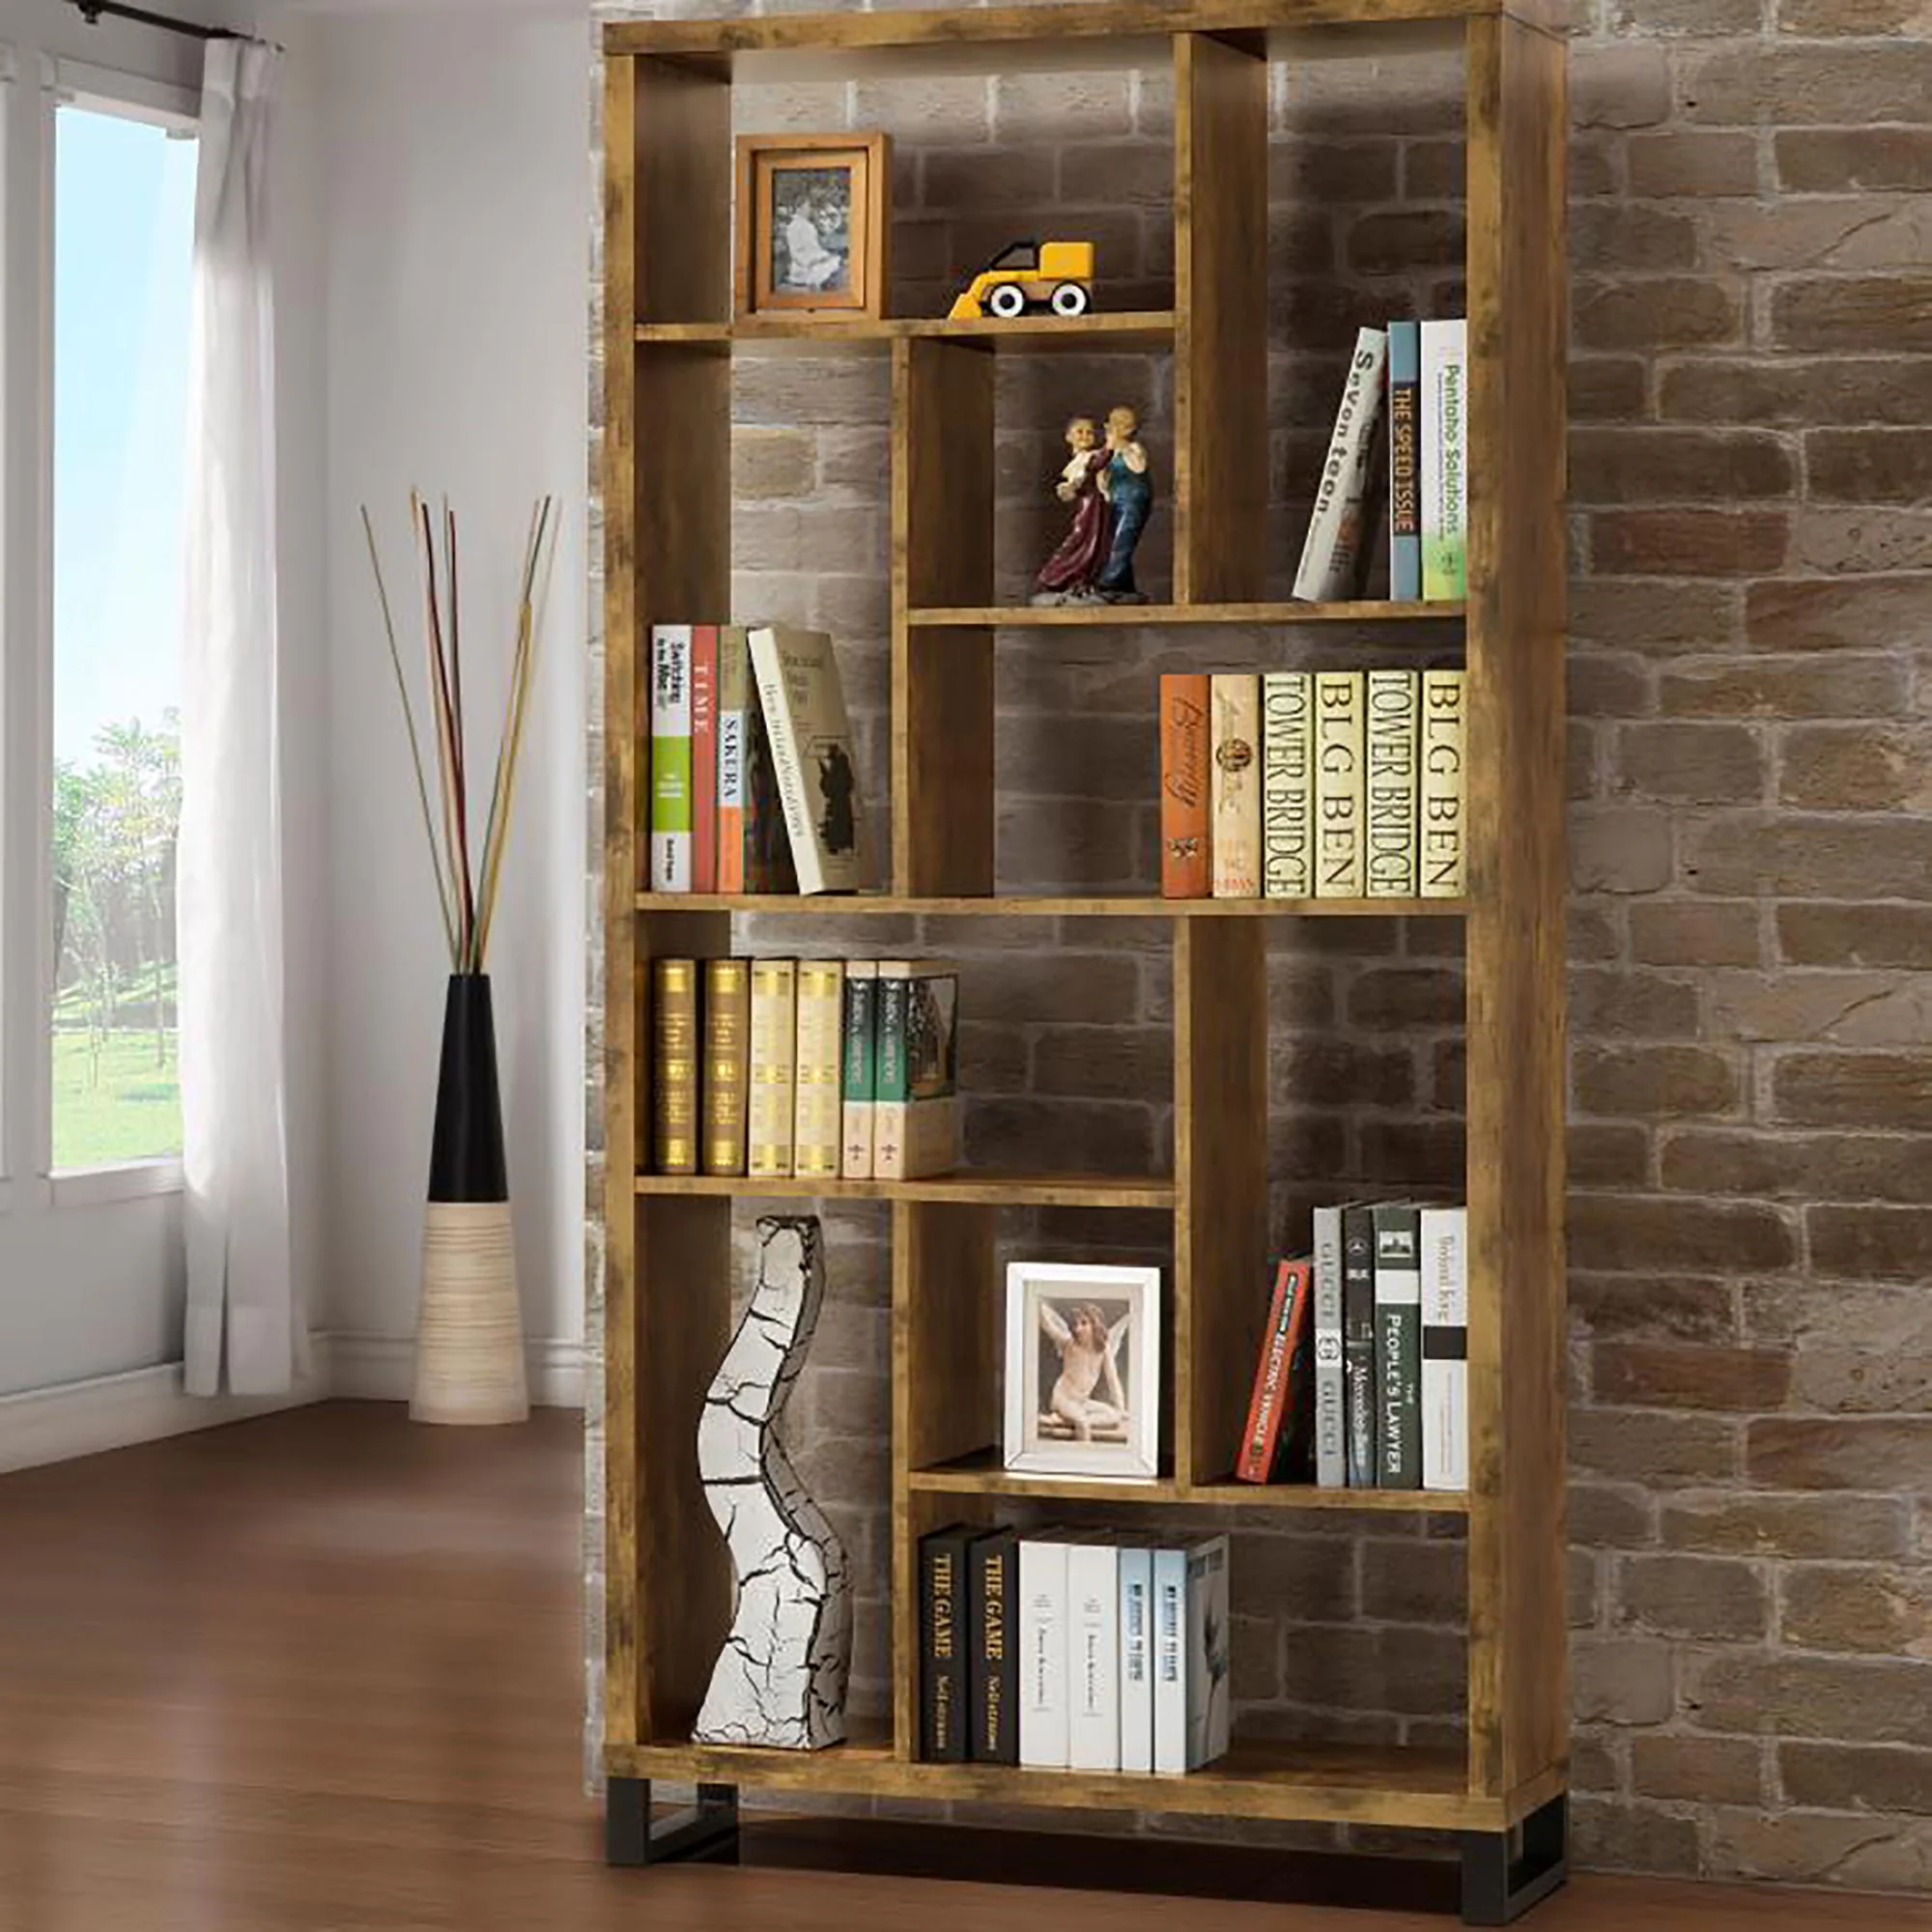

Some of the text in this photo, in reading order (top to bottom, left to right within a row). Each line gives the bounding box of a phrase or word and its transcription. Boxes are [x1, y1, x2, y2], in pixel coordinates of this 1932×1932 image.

[1395, 388, 1413, 532] THE SPEED ISSUE
[1444, 364, 1462, 535] Pentaho Solutions
[694, 661, 709, 734] TIME
[724, 719, 738, 798] SAKURA
[1266, 676, 1307, 894] TOWER BRIDGE
[1370, 673, 1412, 893] TOWER BRIDGE
[1322, 795, 1355, 887] BEN
[1427, 795, 1460, 887] BEN
[1321, 1242, 1336, 1319] GUCCI
[1321, 1379, 1337, 1457] GUCCI
[1386, 1314, 1401, 1473] PEOPLE'S LAWYER
[933, 1553, 952, 1658] THE GAME
[985, 1555, 1003, 1661] THE GAME
